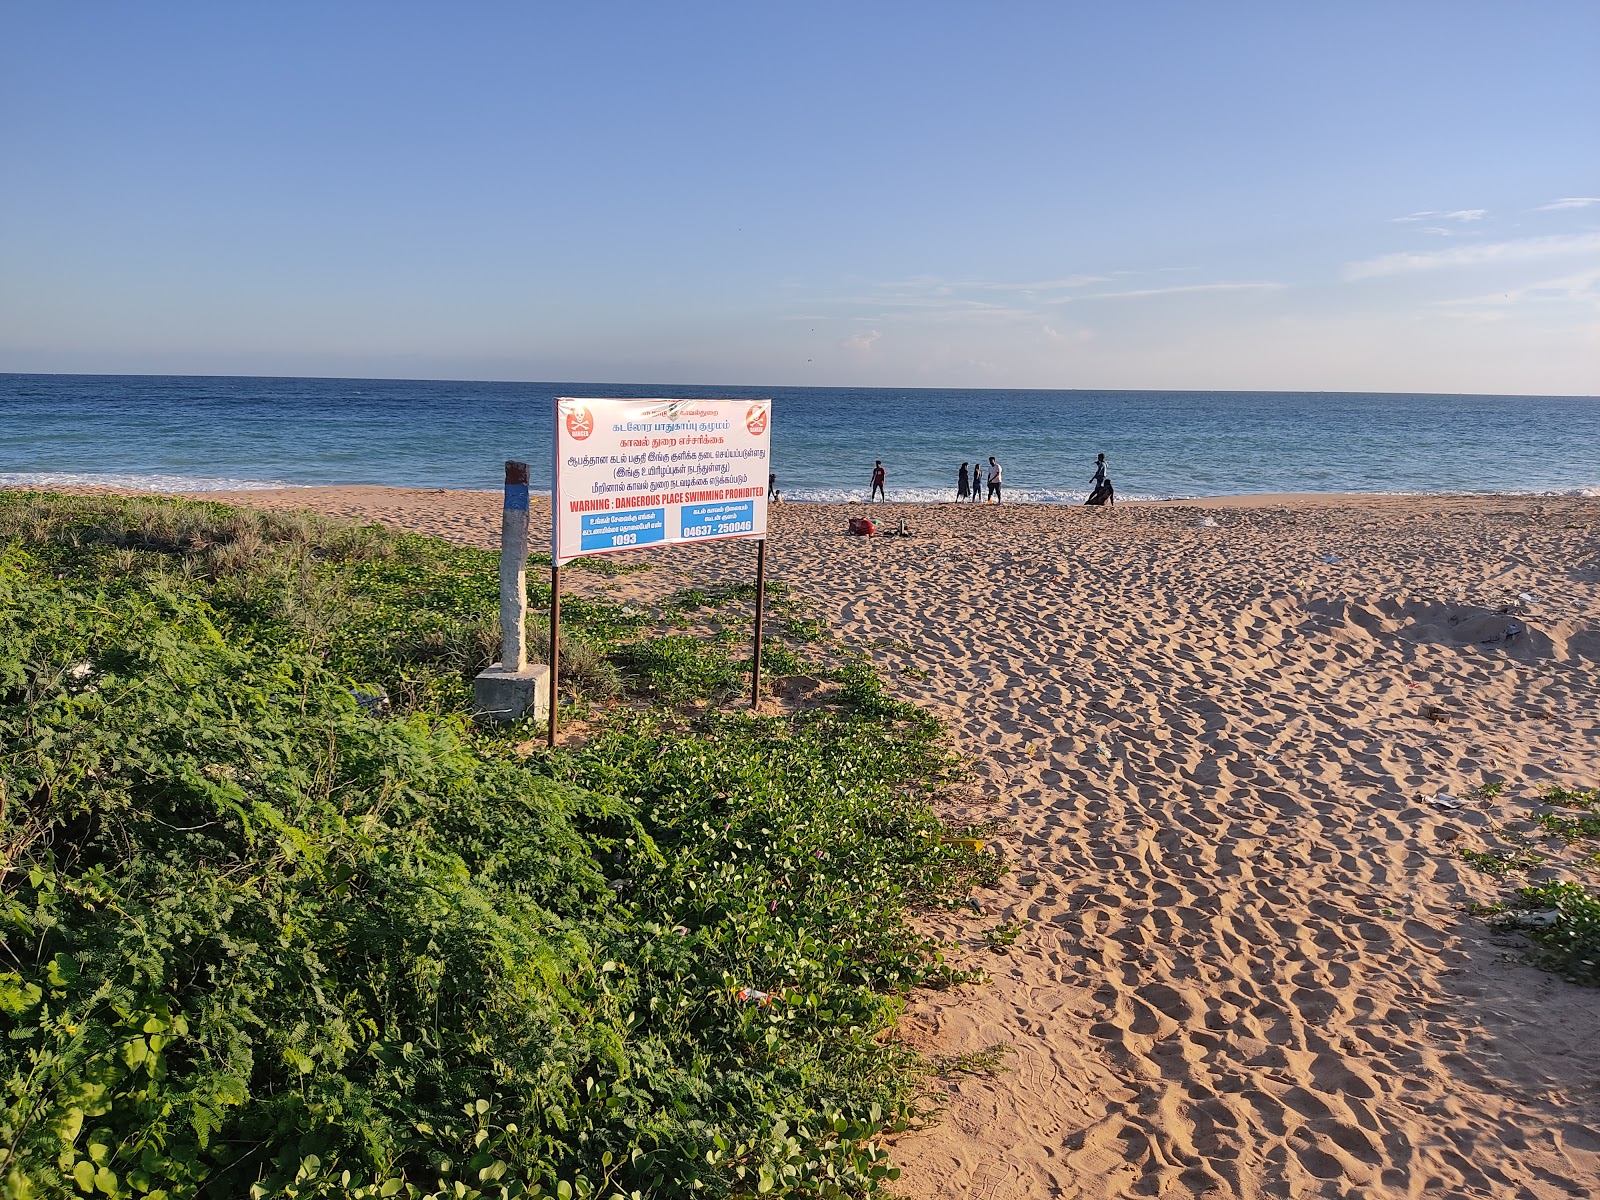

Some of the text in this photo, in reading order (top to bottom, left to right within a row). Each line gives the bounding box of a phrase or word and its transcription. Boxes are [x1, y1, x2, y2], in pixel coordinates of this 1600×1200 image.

[612, 421, 653, 432] கடலோர
[654, 420, 697, 433] பாதுகாப்பு
[619, 434, 724, 449] காவல் துறை எச்சரிக்கை
[567, 454, 608, 468] ஆபத்தான
[610, 453, 627, 464] கடல்
[628, 452, 647, 466] பகுதி
[648, 451, 669, 463] இங்கு
[670, 449, 697, 463] குளிக்க
[698, 450, 714, 461] தடை
[591, 481, 625, 496] மீறினால்
[626, 480, 649, 491] காவல்
[649, 480, 669, 493] துறை
[670, 476, 709, 490] நடவடிக்கை
[570, 498, 610, 513] WARNING
[615, 494, 660, 509] DANGEROUS
[661, 493, 683, 505] PLACE
[684, 490, 724, 503] SWIMMING
[725, 486, 764, 500] PROHIBITED
[683, 525, 712, 538] 04637
[718, 521, 752, 534] 250046
[611, 533, 637, 546] 1093
